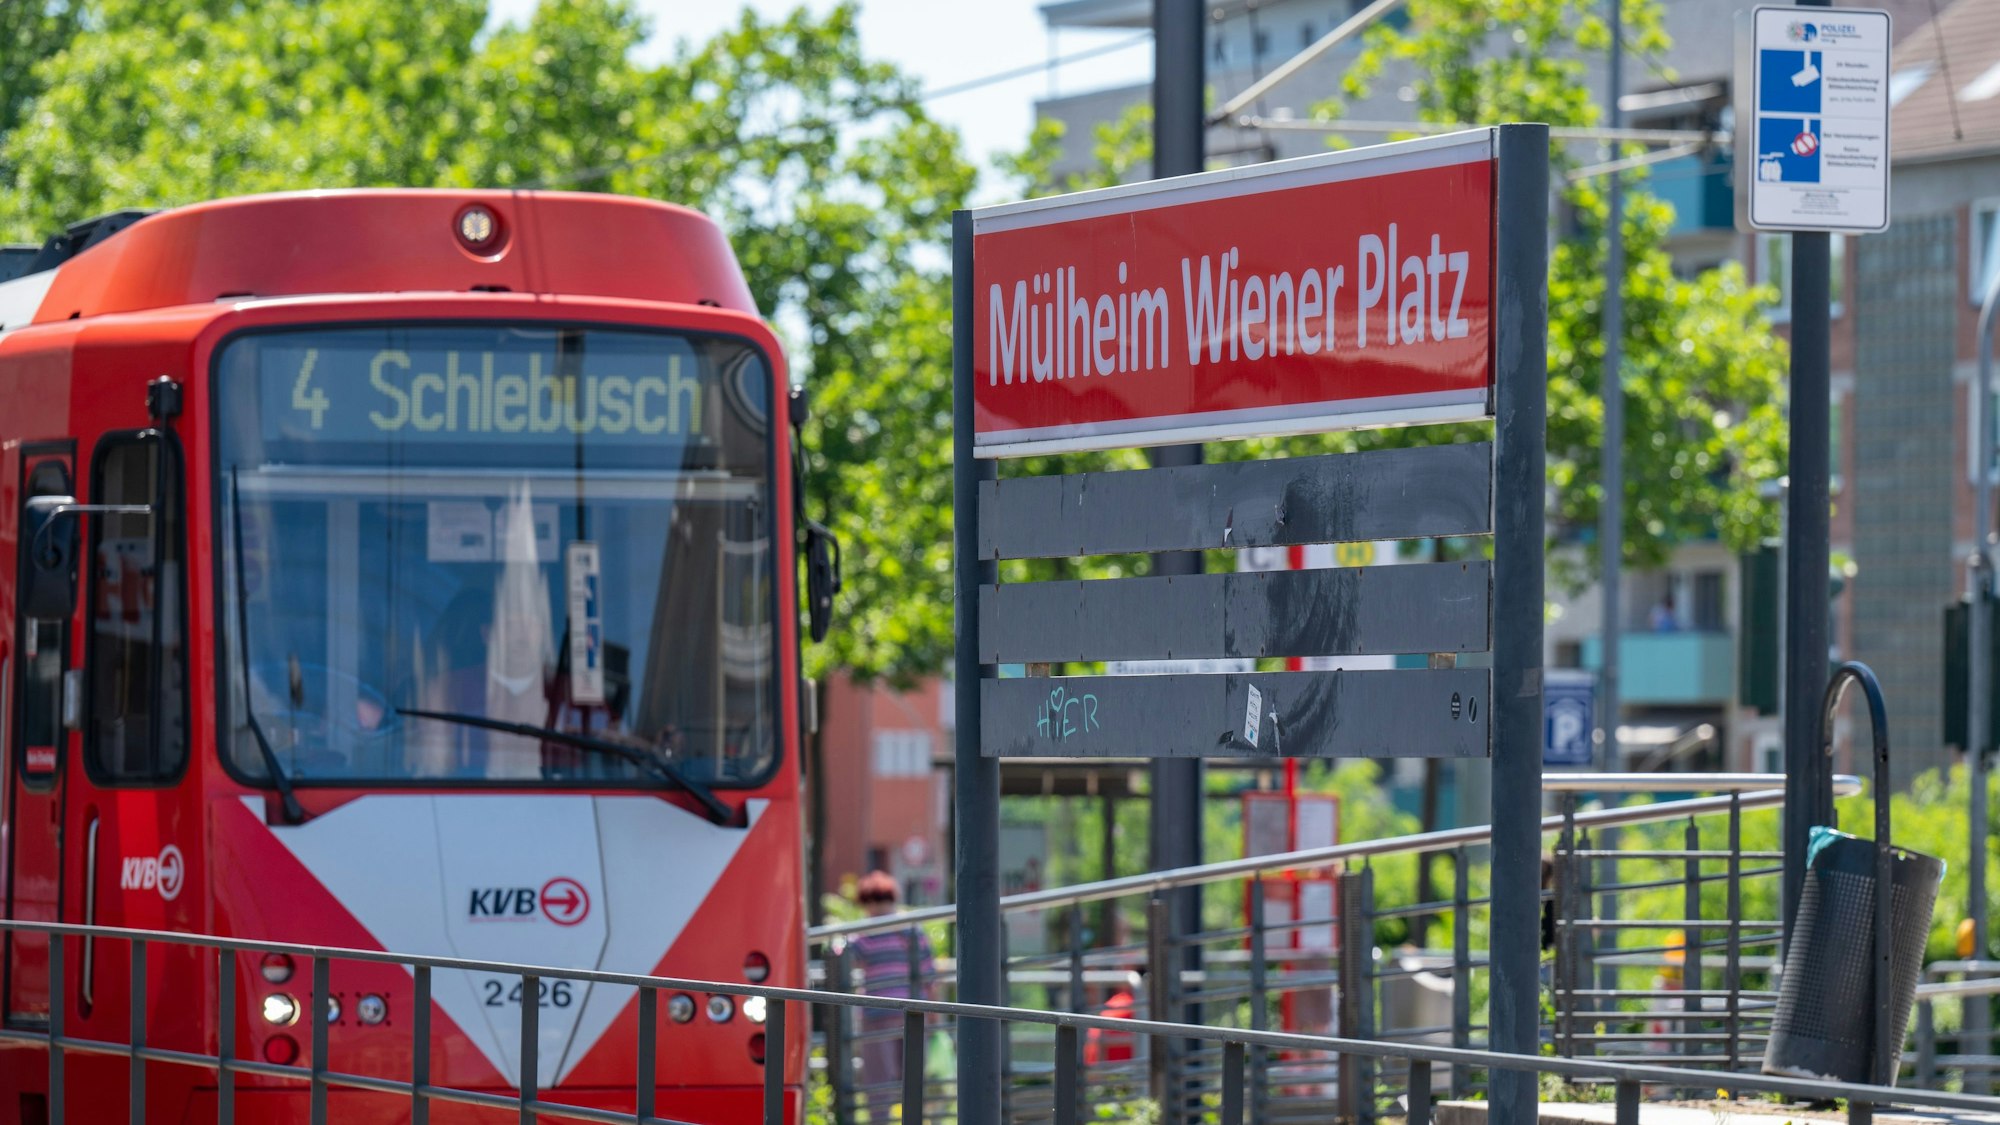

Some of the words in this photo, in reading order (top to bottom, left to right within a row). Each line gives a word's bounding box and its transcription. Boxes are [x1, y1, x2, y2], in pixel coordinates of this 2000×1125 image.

[1821, 23, 1856, 34] POLIZEI
[988, 260, 1170, 388] Mülheim
[1181, 246, 1345, 367] Wiener
[1357, 221, 1471, 350] Platz
[291, 348, 330, 430] 4
[368, 349, 702, 435] Schlebusch
[1552, 708, 1582, 754] P
[120, 856, 157, 891] KVB
[468, 887, 536, 917] KVB
[483, 978, 574, 1009] 2426
